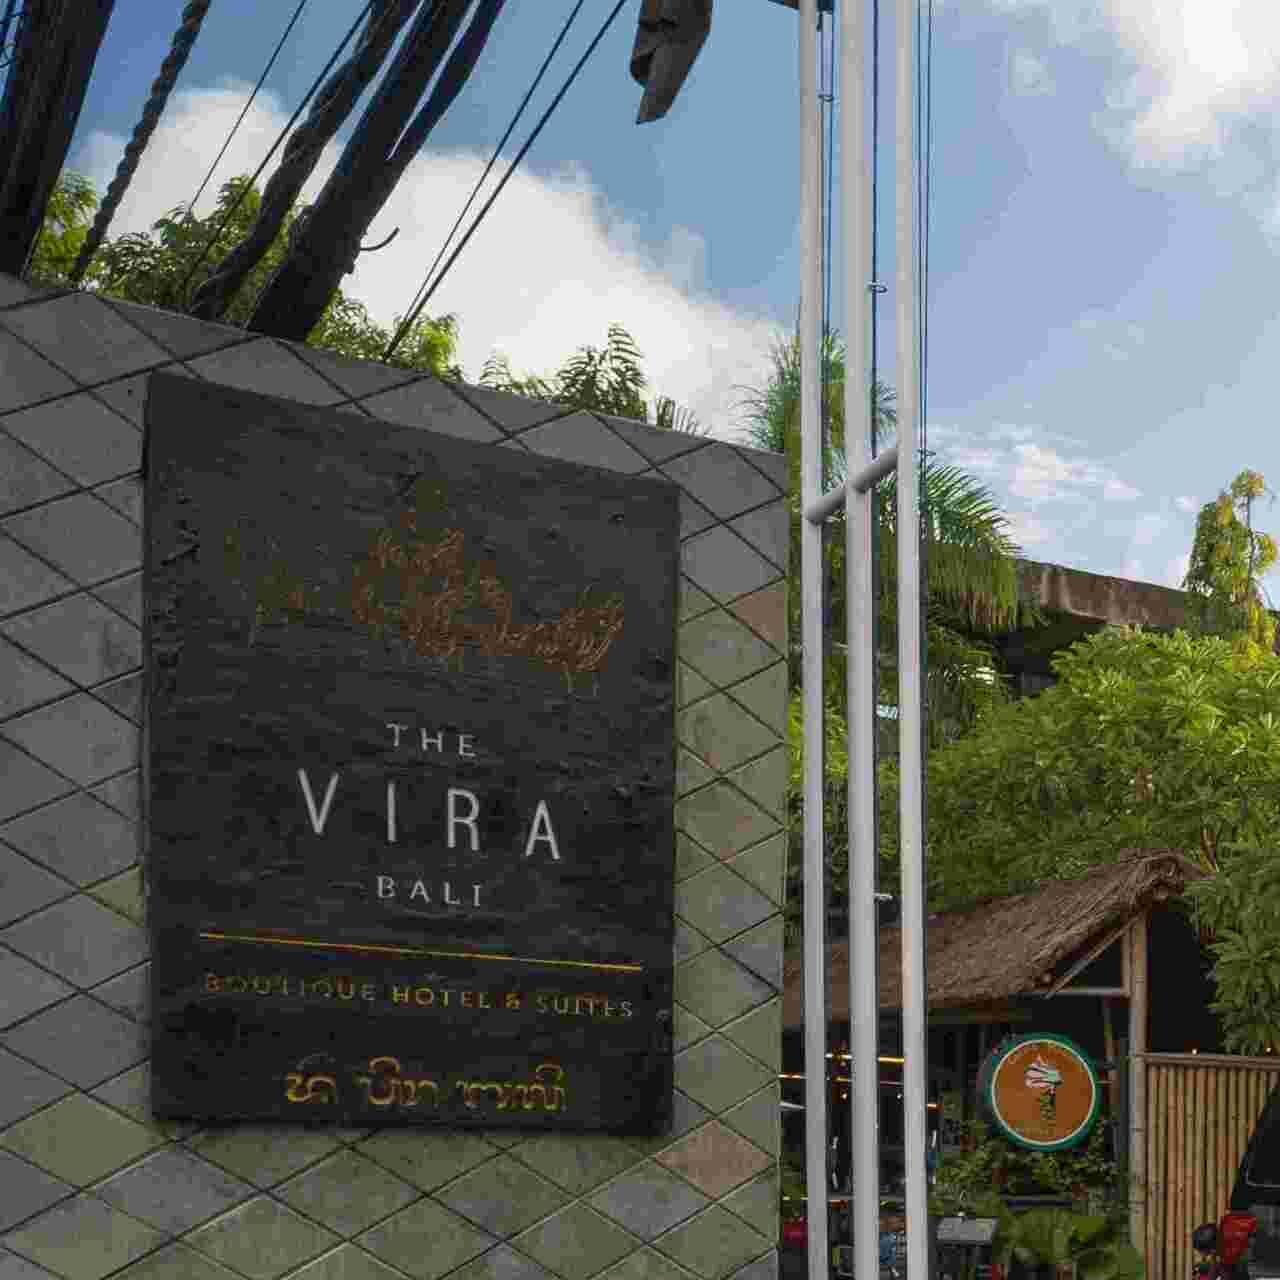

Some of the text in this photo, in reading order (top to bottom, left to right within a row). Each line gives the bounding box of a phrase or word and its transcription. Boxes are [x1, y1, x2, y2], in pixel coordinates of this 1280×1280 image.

[384, 722, 478, 757] THE
[298, 767, 561, 861] VIRA
[376, 874, 483, 908] BALI
[204, 972, 634, 1018] BOUTIQUE HOTEL & SUITES
